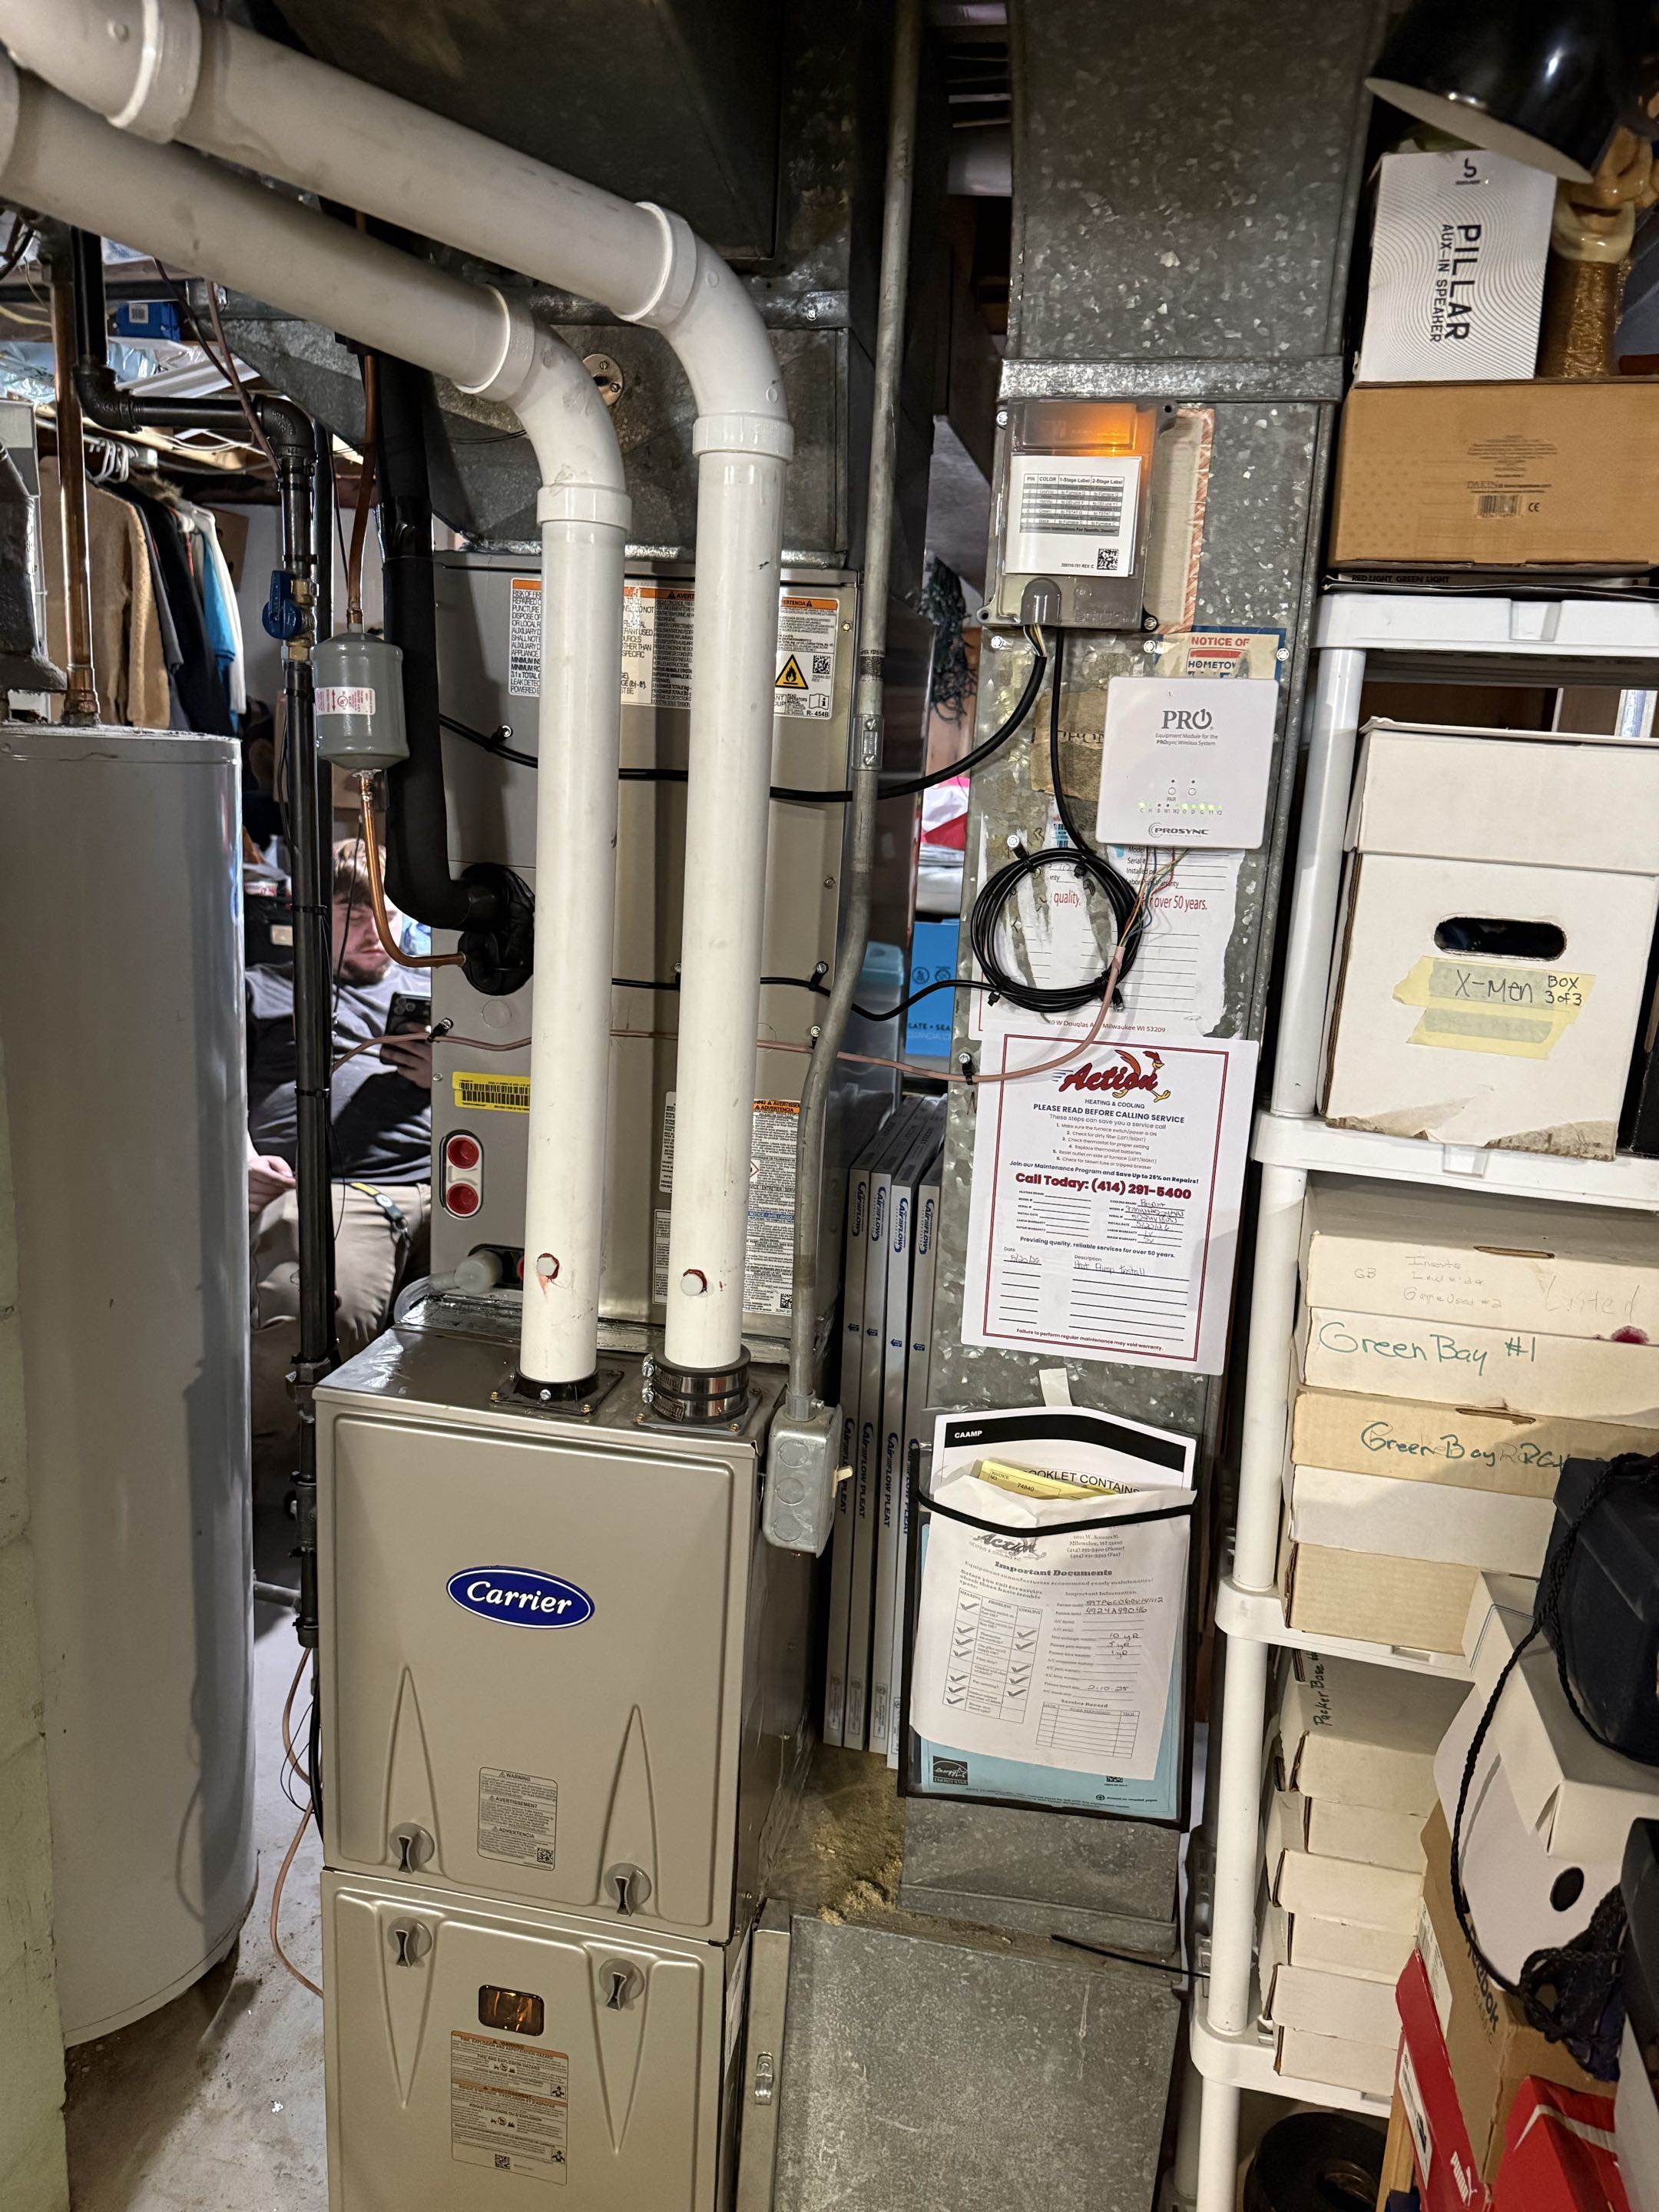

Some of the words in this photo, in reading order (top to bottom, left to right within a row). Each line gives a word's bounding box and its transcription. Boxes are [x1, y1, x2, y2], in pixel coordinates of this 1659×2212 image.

[1438, 224, 1453, 272] AUX-IN
[1445, 224, 1481, 339] PILLAR
[1429, 280, 1447, 342] SPEAKER
[1191, 636, 1232, 646] NOTICE
[1235, 637, 1250, 647] OF
[1054, 892, 1081, 906] quality.
[1154, 897, 1172, 908] over
[1174, 896, 1183, 909] 50
[1184, 899, 1207, 912] years.
[1455, 969, 1532, 1003] X-Men
[1548, 975, 1579, 989] BOX
[1058, 1062, 1159, 1093] Action
[1116, 1111, 1150, 1120] CALLING
[1151, 1114, 1184, 1123] SERVICE
[1015, 1173, 1041, 1184] Call
[1044, 1175, 1089, 1191] Today:
[1091, 1178, 1125, 1195] (414)
[1128, 1184, 1191, 1199] 291-5400
[1020, 1237, 1048, 1245] Providing
[1354, 1268, 1377, 1279] GB
[1319, 1322, 1427, 1361] Green
[1431, 1333, 1488, 1376] Bay
[1505, 1336, 1535, 1363] #1
[954, 1430, 982, 1439] CAAMP
[1361, 1422, 1435, 1456] Green
[1440, 1434, 1495, 1467] Bay
[992, 1470, 1009, 1480] INVOICE
[1025, 1469, 1078, 1482] OOKLET
[1080, 1475, 1140, 1493] CONTAINS
[1017, 1482, 1035, 1492] 74840
[995, 1561, 1051, 1576] Important
[466, 1581, 572, 1614] Carrier
[1310, 1664, 1324, 1689] Base
[1313, 1690, 1332, 1726] Packer
[506, 1773, 531, 1782] WARNING
[495, 1796, 538, 1809] AVERTISSEMENT
[499, 1828, 535, 1838] ADVERTENCIA
[1451, 2151, 1470, 2206] PUMA
